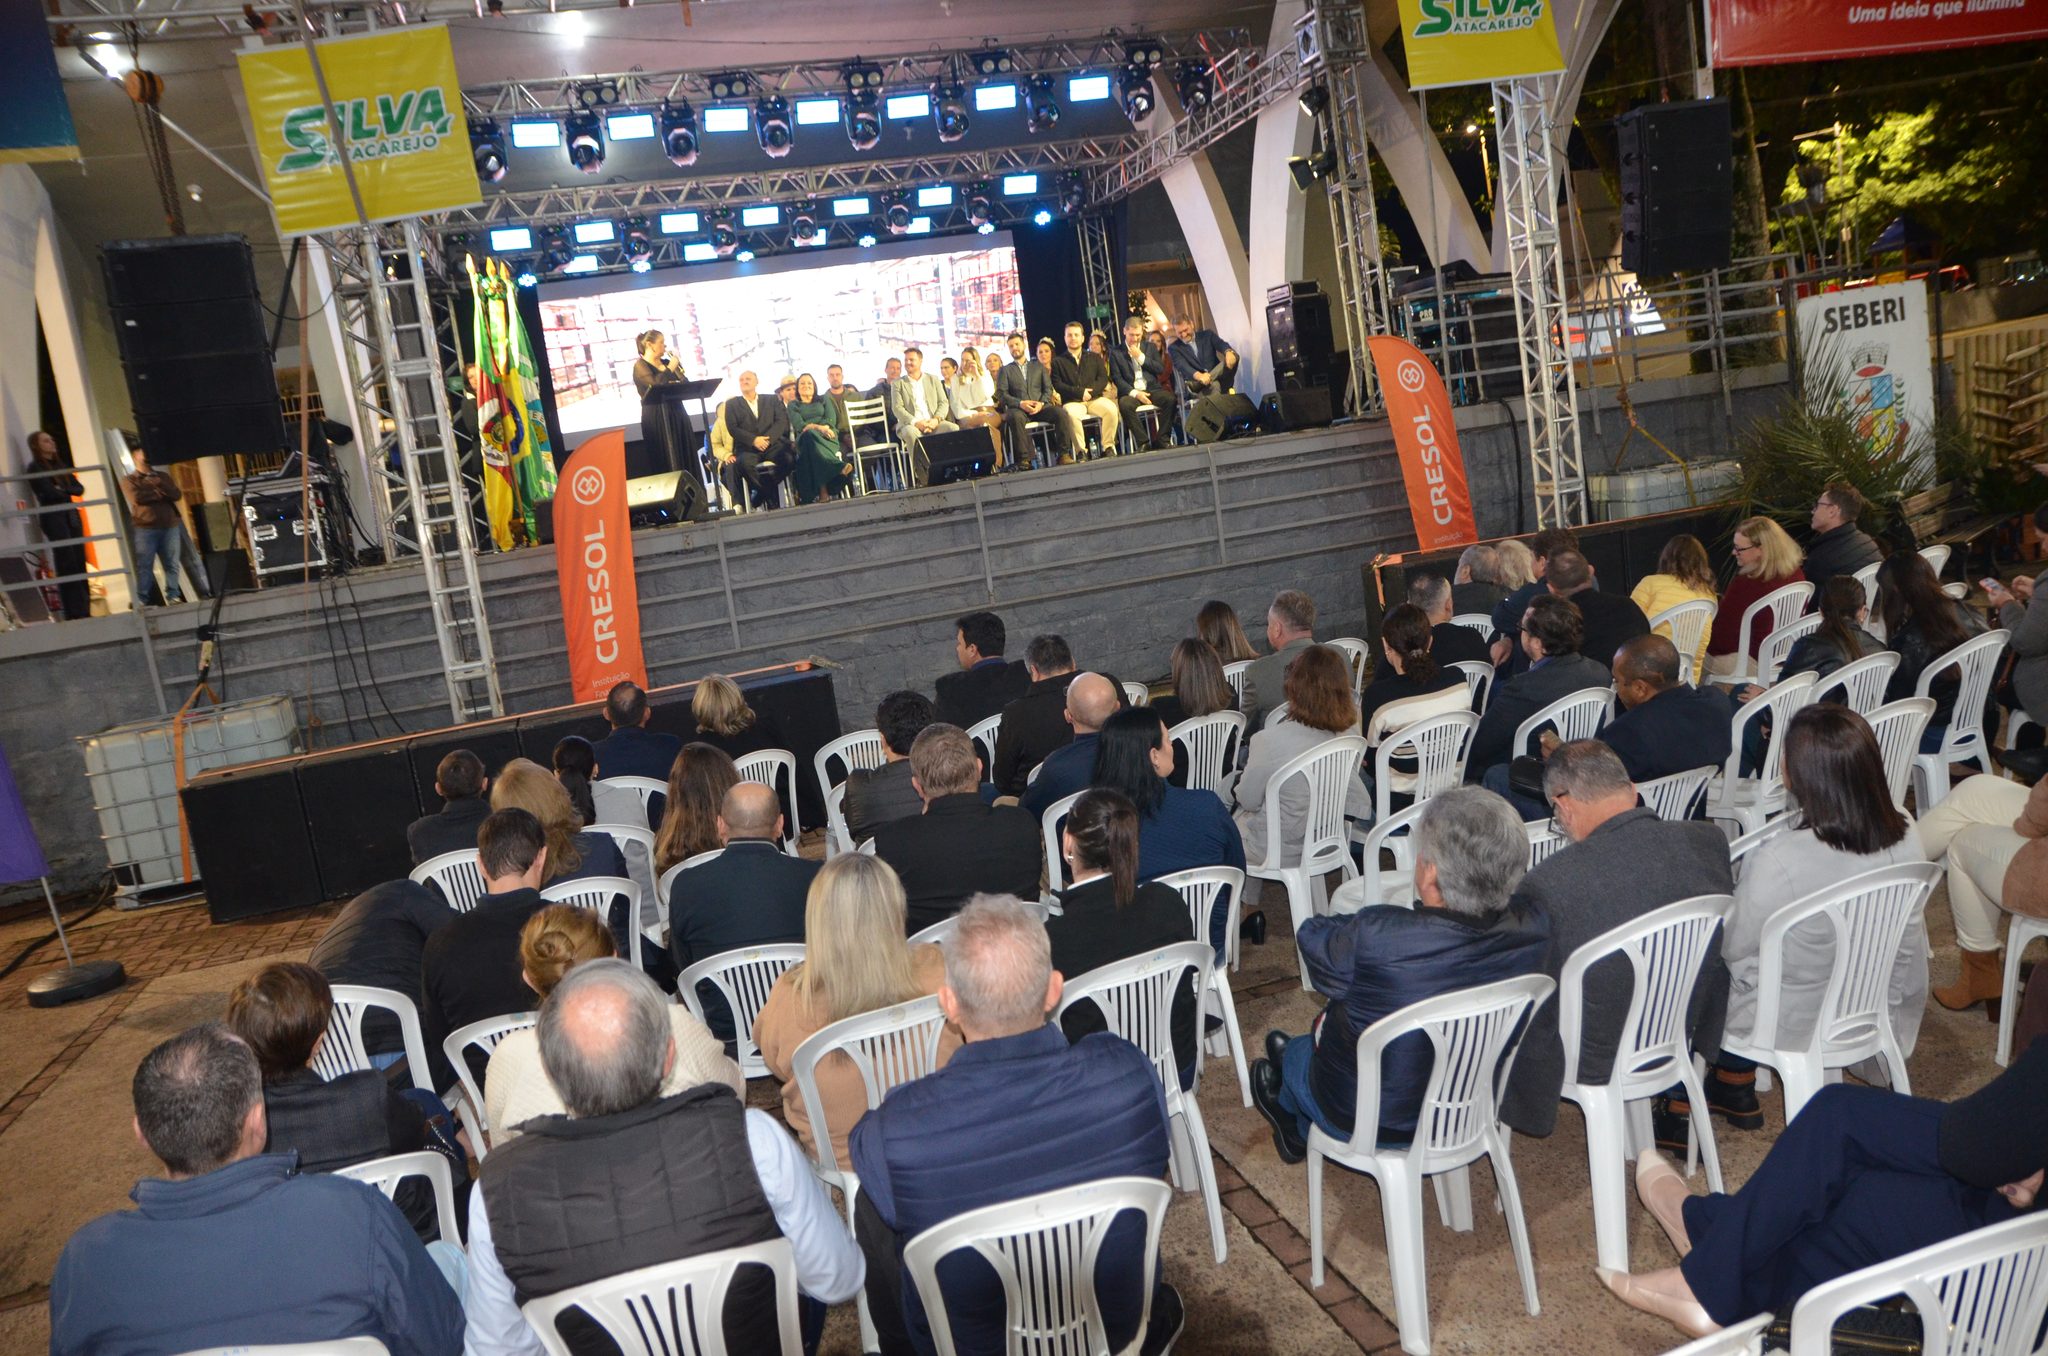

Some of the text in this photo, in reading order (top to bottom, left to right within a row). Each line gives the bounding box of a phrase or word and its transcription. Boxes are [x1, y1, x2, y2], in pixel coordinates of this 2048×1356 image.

[1453, 16, 1533, 33] ATACAREJO
[1849, 6, 1886, 24] Uma
[1889, 3, 1929, 20] ideia
[1933, 1, 1963, 20] que
[328, 135, 437, 164] AACAREJO
[1823, 296, 1906, 334] SEBERI
[1413, 403, 1453, 526] CRESOL
[584, 519, 619, 665] CRESOL
